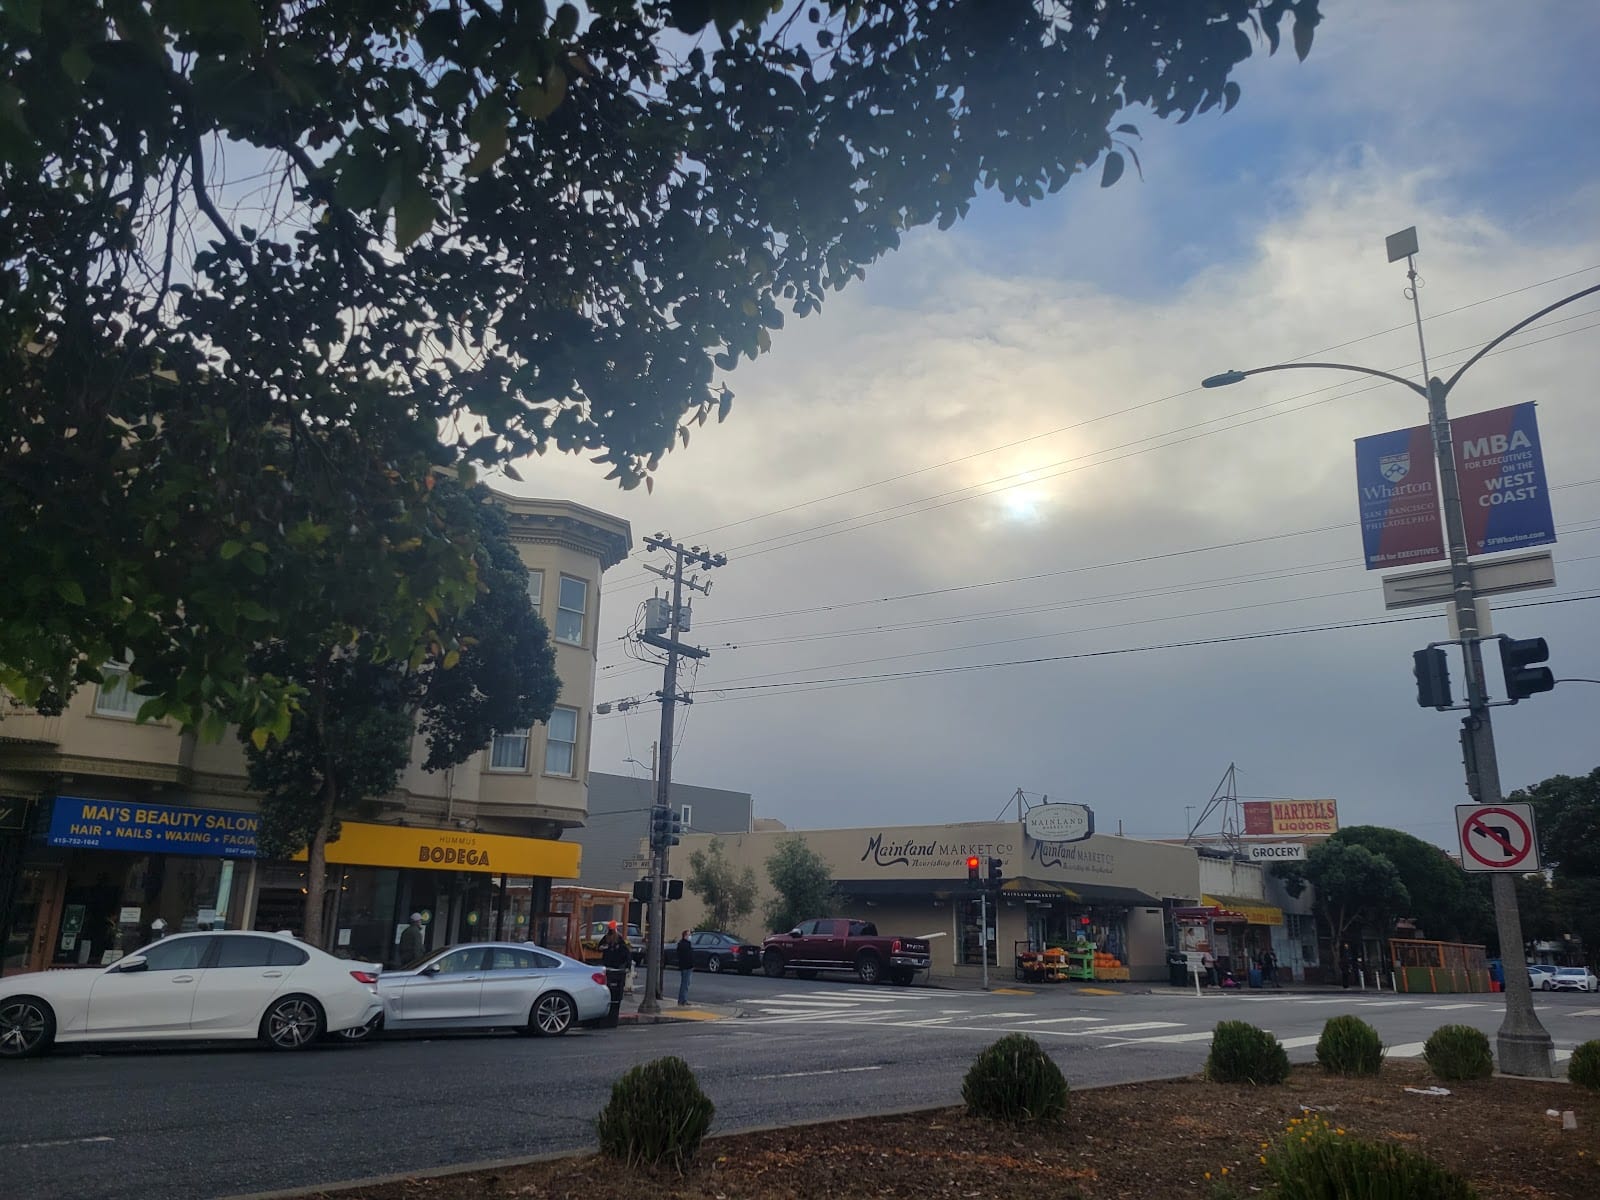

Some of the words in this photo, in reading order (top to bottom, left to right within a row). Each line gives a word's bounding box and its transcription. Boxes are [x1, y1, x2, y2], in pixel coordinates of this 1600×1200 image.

[1463, 430, 1532, 460] MBA
[1465, 461, 1481, 470] FOR
[1483, 451, 1533, 467] EXECUTIVES
[1502, 464, 1515, 473] ON
[1517, 461, 1533, 470] THE
[1485, 471, 1535, 491] WEST
[1364, 481, 1432, 500] Wharton
[1479, 486, 1537, 507] COAST
[1364, 510, 1381, 519] SAN
[1384, 502, 1434, 516] FRANCISCO
[1366, 514, 1436, 530] PHILADELPHIA
[1487, 531, 1545, 546] SFWharton.com
[1397, 547, 1440, 559] EXECUTIVES
[81, 805, 131, 822] MAI'S
[135, 809, 203, 827] BEAUTY
[205, 815, 258, 832] SALON
[1274, 802, 1335, 820] MARTELLS
[1031, 818, 1083, 826] MAINLAND
[1279, 822, 1331, 831] LIQUORS
[70, 824, 102, 836] HAIR
[116, 828, 153, 840] NAILS
[165, 831, 211, 844] WAXING
[439, 836, 477, 846] HUMMUS
[418, 846, 490, 866] BODEGA
[861, 833, 937, 867] Mainland
[939, 844, 993, 855] MARKET
[1252, 847, 1301, 858] GROCERY
